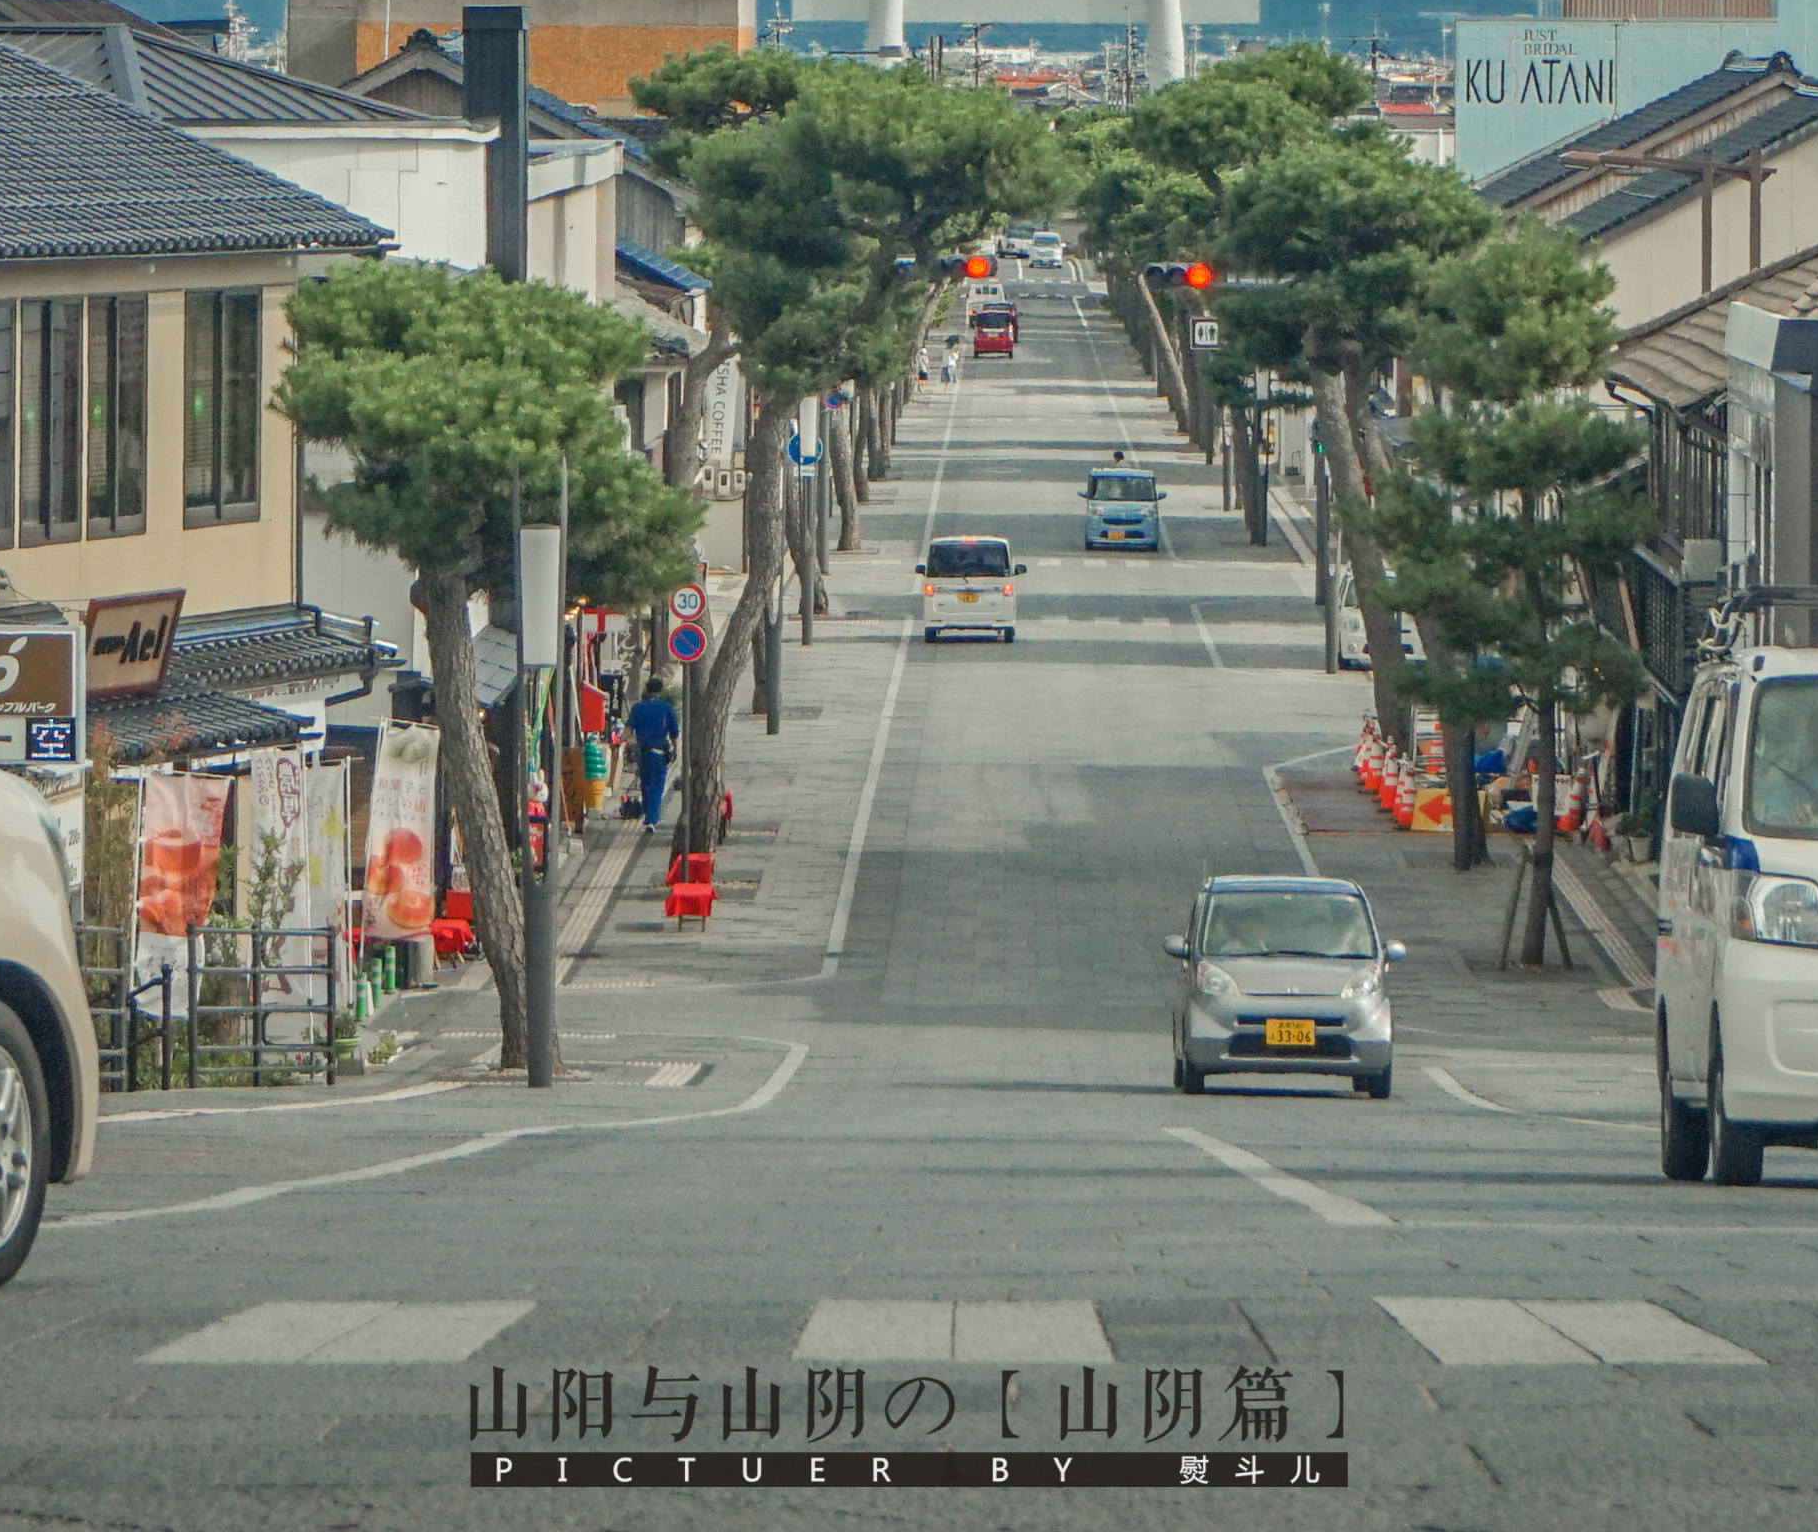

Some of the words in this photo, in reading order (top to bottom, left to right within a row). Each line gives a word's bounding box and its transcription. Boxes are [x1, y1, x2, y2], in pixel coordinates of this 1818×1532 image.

[1522, 29, 1557, 42] JUST
[1523, 43, 1578, 56] BRIDAL
[710, 400, 726, 455] COFFEE
[677, 593, 698, 609] 30
[31, 719, 71, 759] 空
[1277, 1029, 1311, 1043] 33-06
